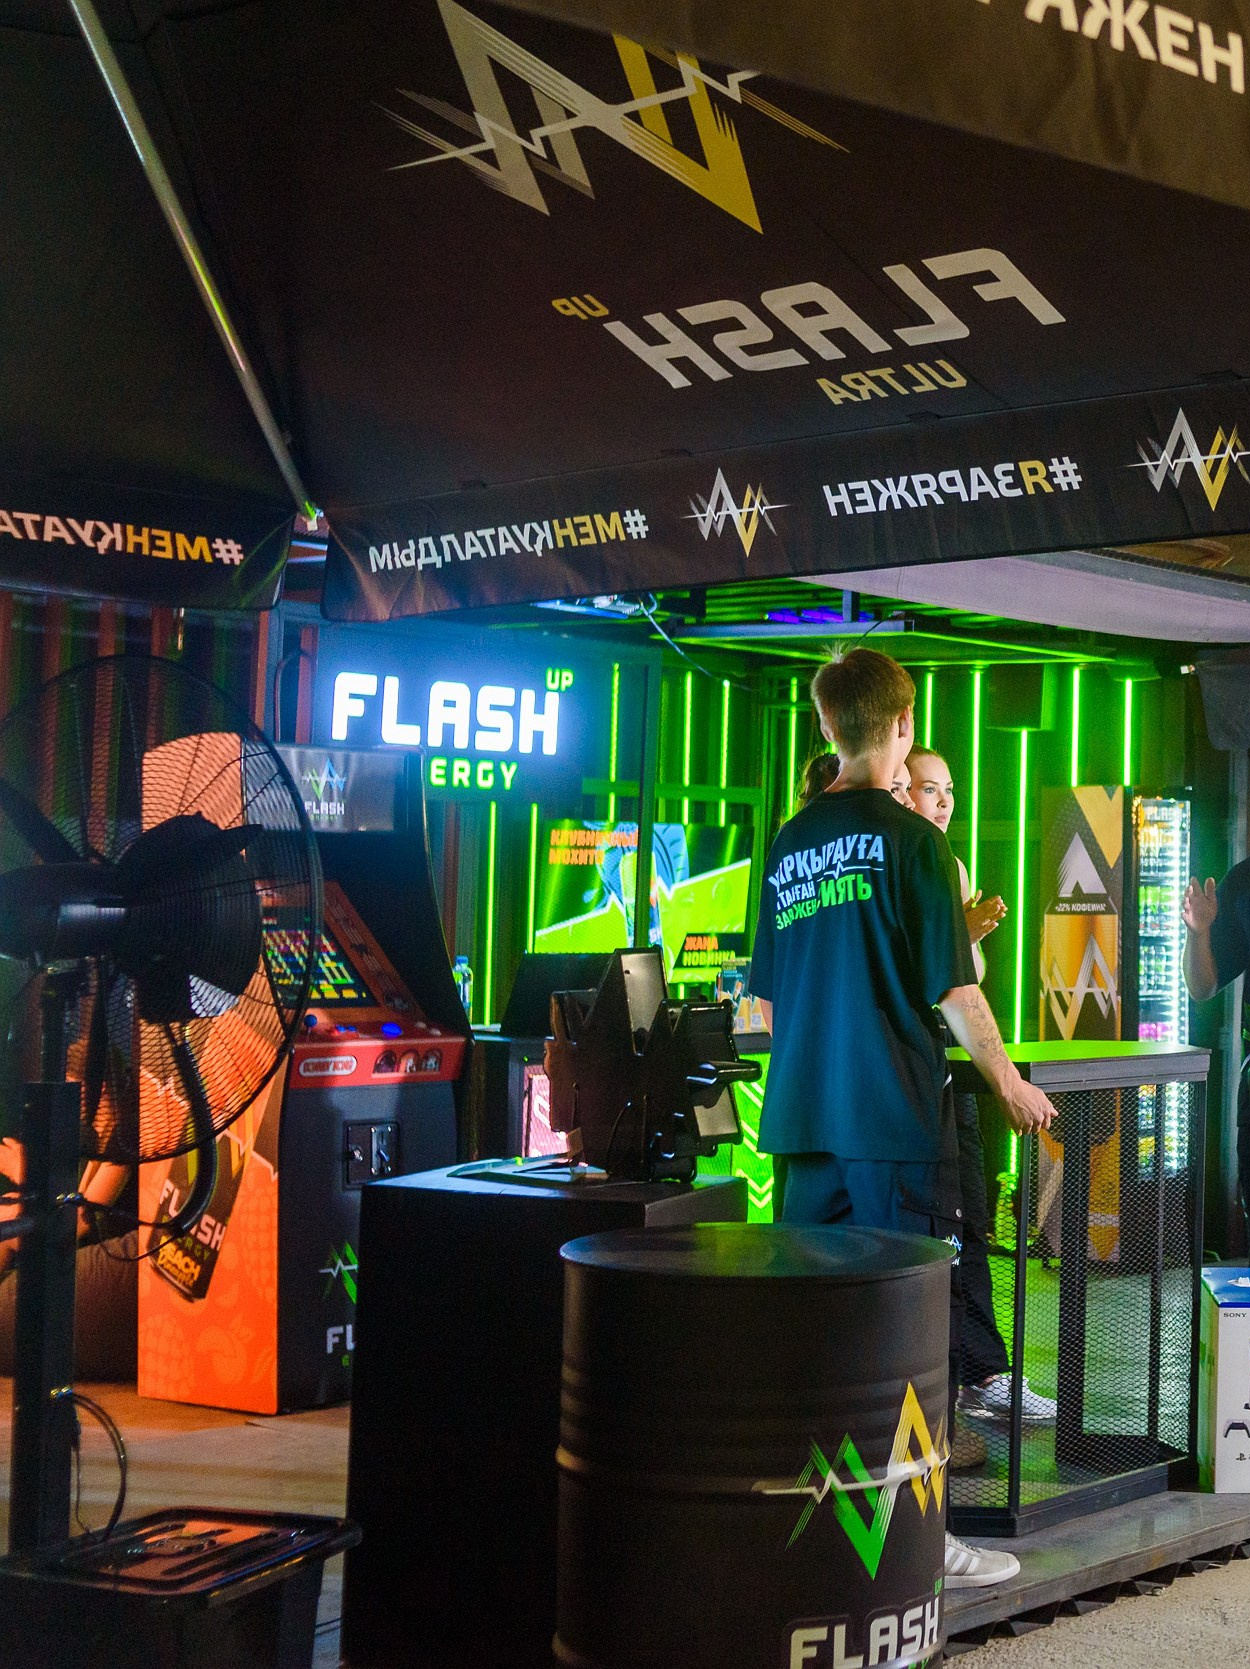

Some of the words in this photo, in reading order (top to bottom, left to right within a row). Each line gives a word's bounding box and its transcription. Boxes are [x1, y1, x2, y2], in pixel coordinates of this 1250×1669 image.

[546, 668, 575, 692] UP
[331, 671, 561, 756] FLASH
[429, 756, 519, 791] ERGY
[304, 801, 345, 815] FLASH
[159, 1178, 227, 1252] FLSH
[790, 1596, 940, 1669] FLASH
